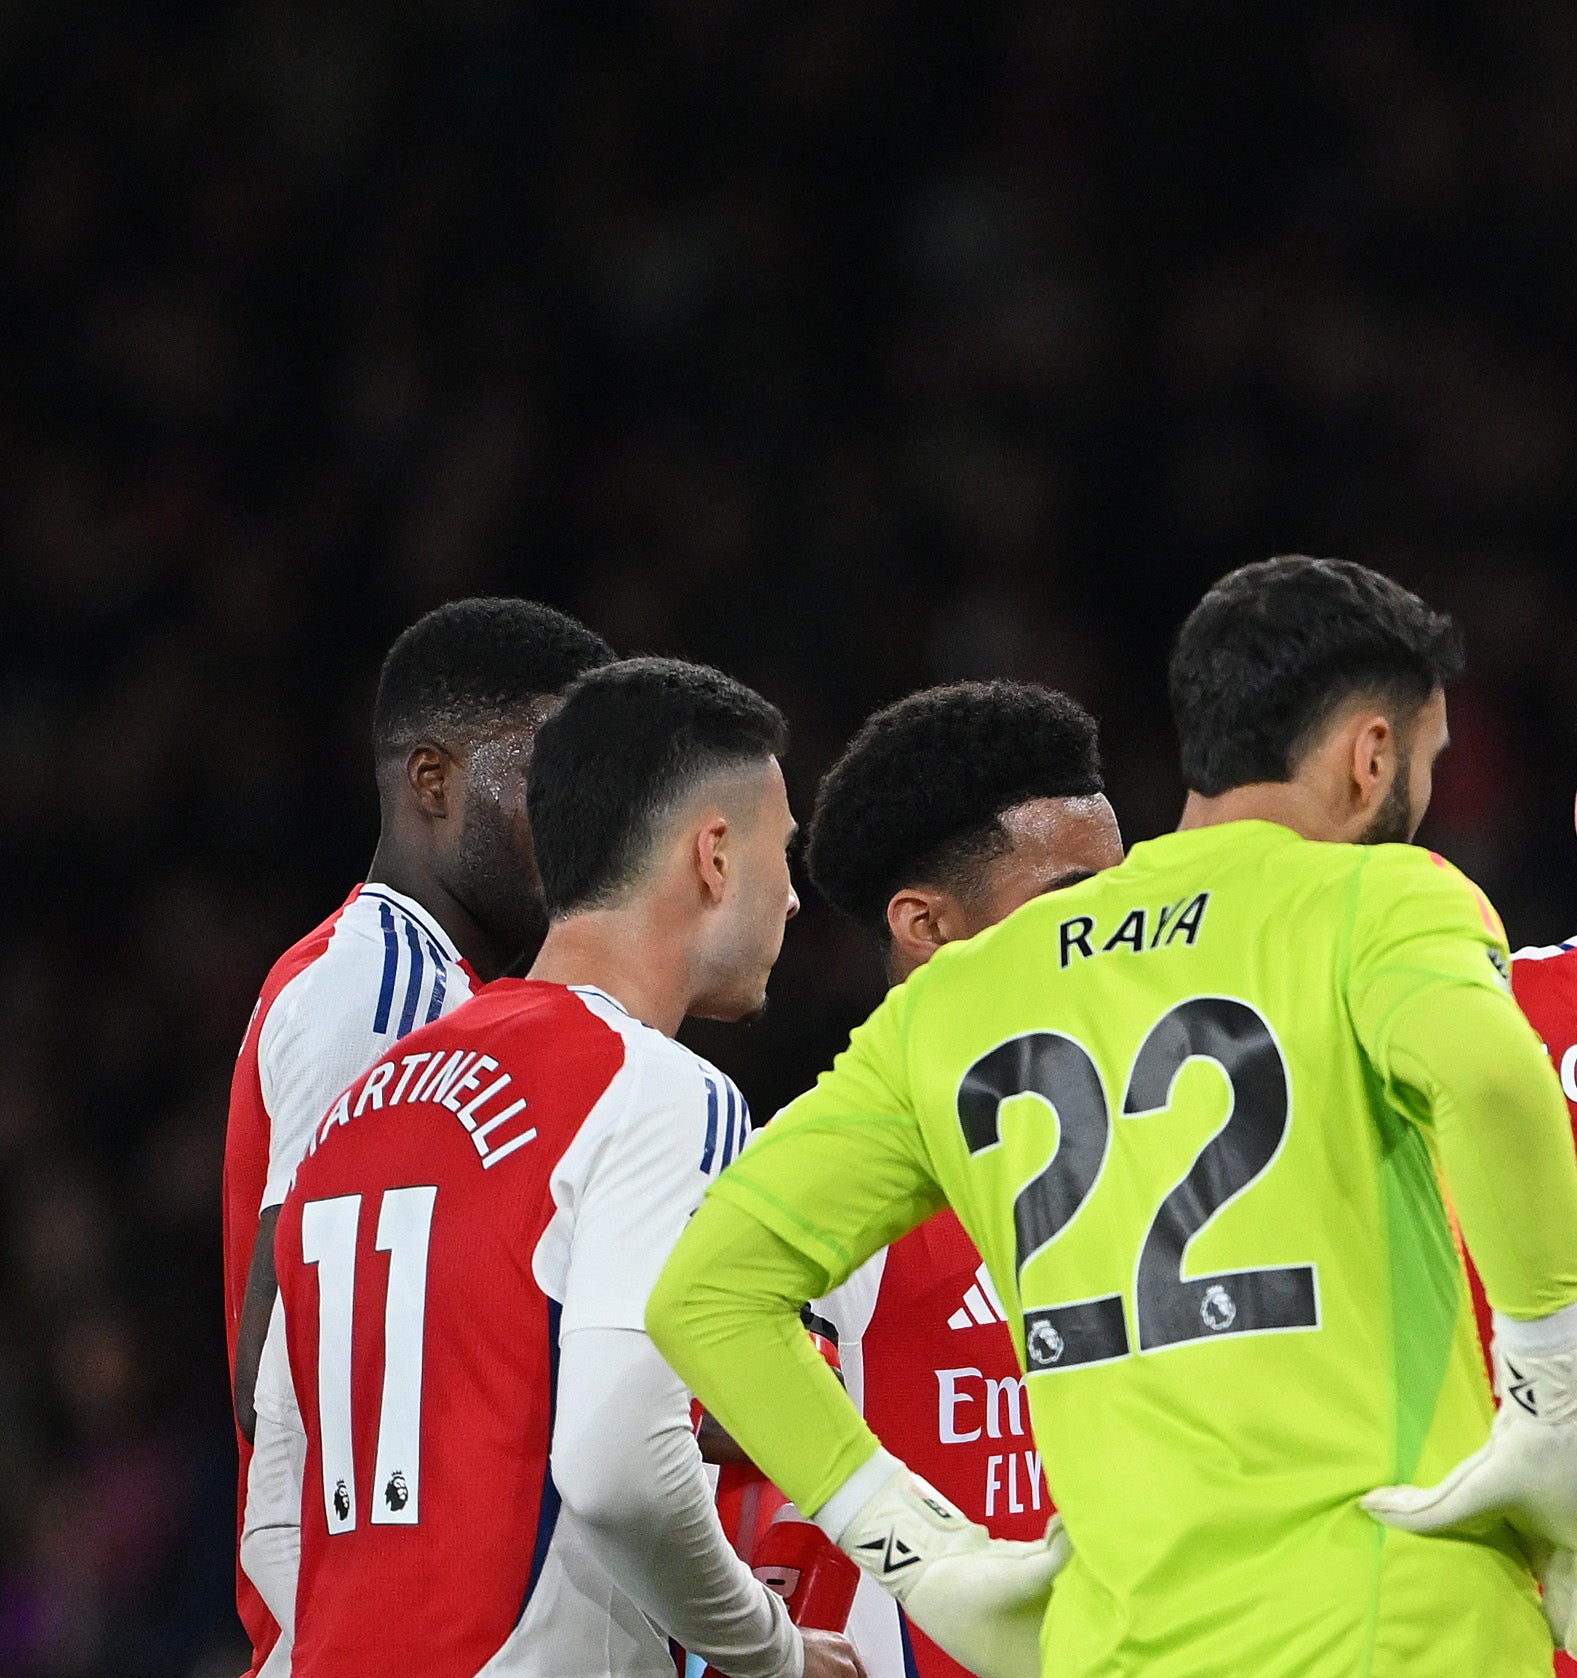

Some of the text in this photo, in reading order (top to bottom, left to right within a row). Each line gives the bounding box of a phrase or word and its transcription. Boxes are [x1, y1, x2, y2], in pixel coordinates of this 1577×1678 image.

[1058, 891, 1210, 969] RAYA
[956, 993, 1322, 1374] 22
[302, 1186, 438, 1536] 11
[985, 1450, 1041, 1517] FLY
